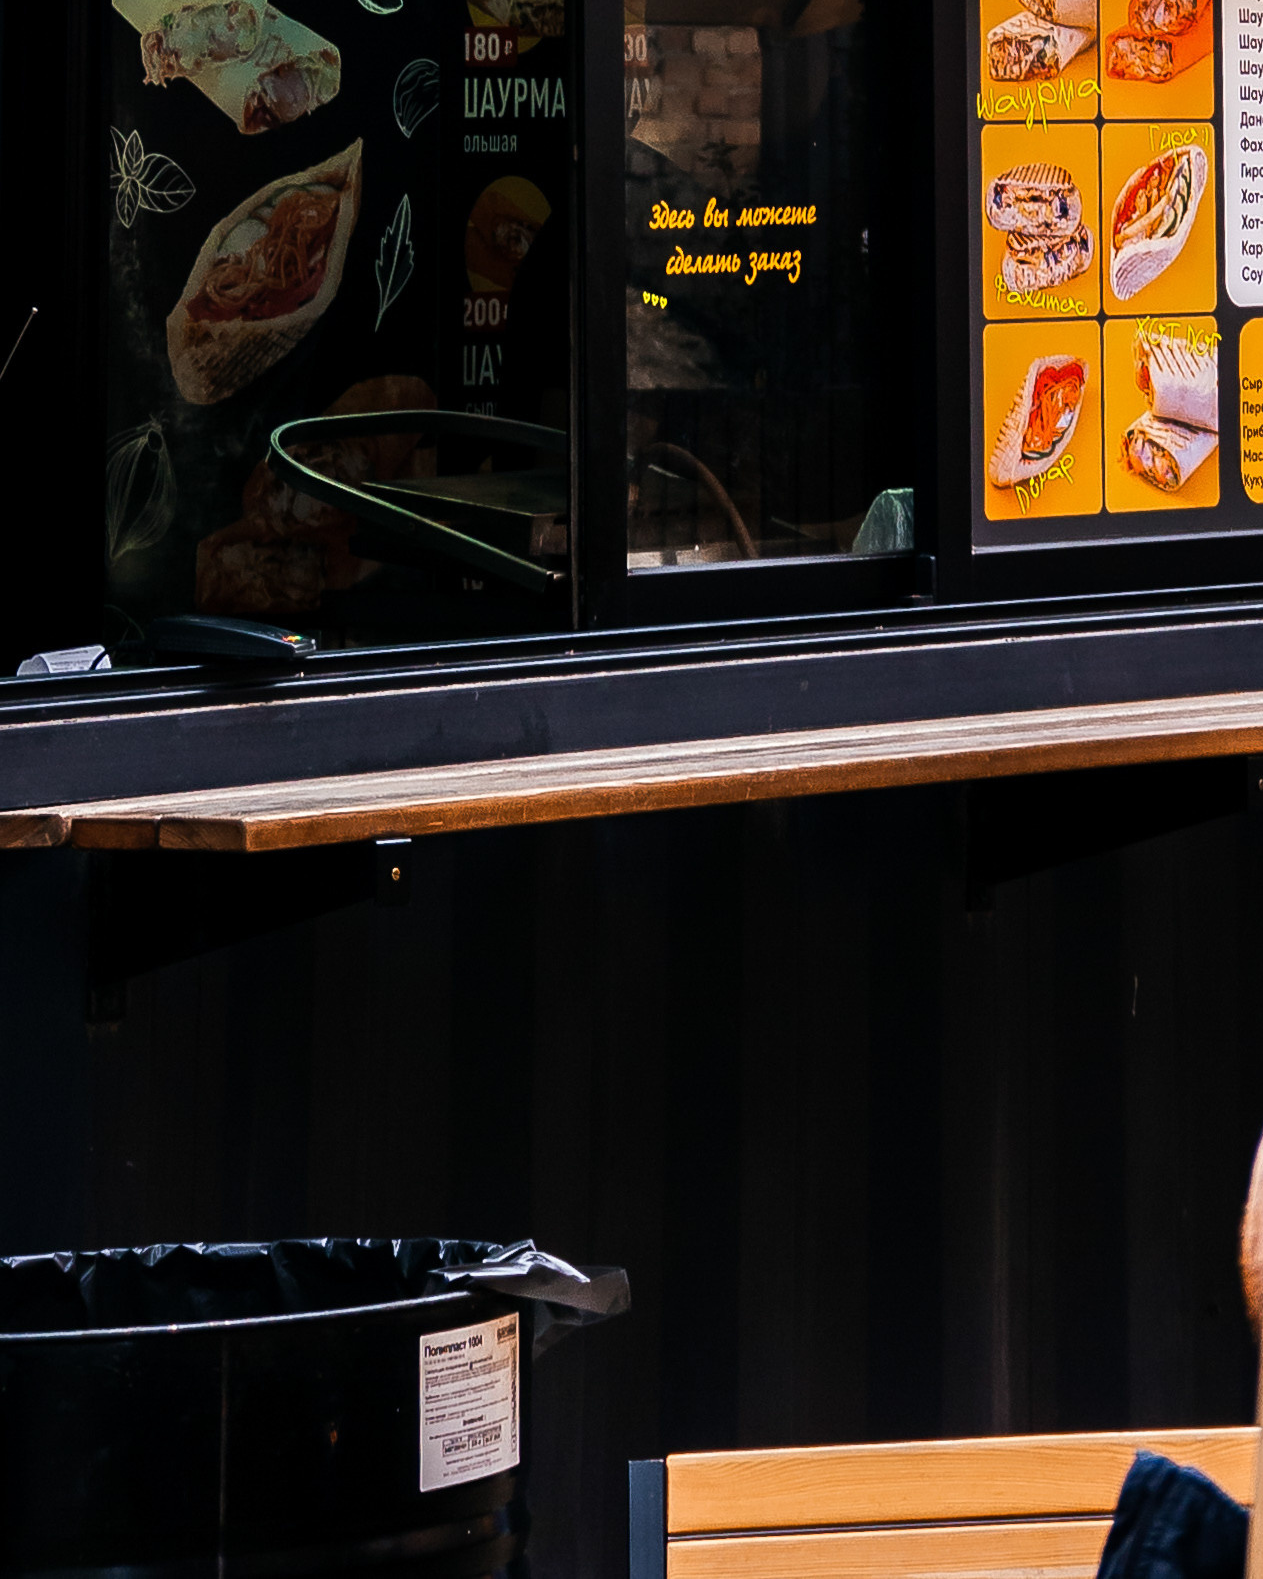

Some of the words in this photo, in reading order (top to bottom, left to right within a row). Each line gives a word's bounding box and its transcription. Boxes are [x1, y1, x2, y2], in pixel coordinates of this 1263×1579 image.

[649, 200, 695, 229] Здесь
[704, 197, 729, 228] вы
[736, 205, 817, 227] можете
[666, 245, 742, 275] сделать
[744, 250, 802, 286] заказ
[1242, 377, 1262, 392] Сыр
